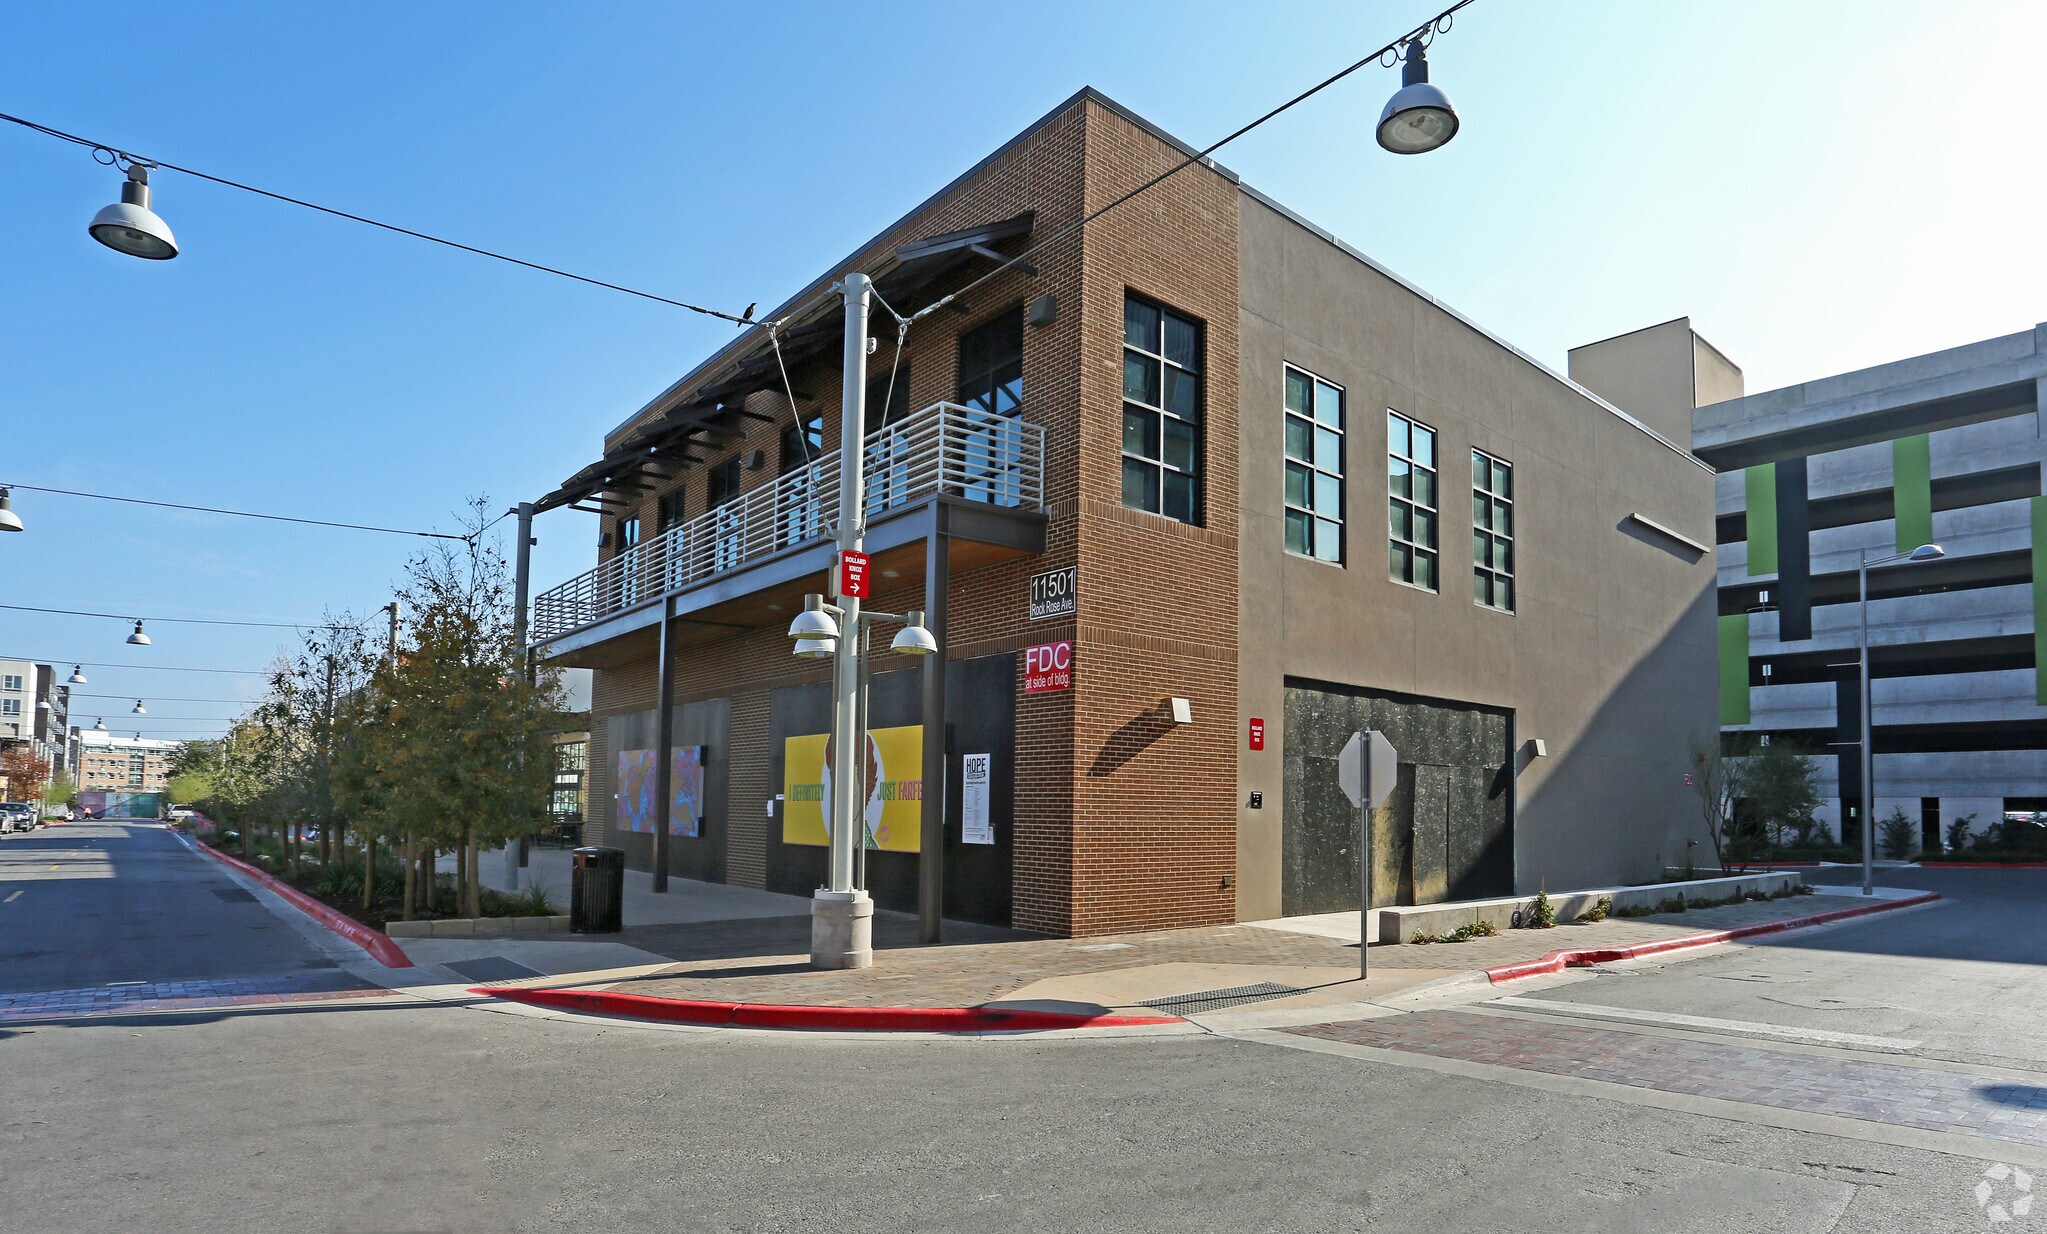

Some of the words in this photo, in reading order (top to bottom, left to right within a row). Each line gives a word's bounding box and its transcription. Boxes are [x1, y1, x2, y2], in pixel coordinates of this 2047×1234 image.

[845, 556, 866, 565] BOLLARD
[849, 565, 862, 573] KNOX
[1032, 569, 1073, 600] 11501
[1031, 602, 1046, 617] Rock
[1046, 600, 1061, 614] Rose
[1061, 597, 1074, 611] Ave.
[1026, 642, 1070, 674] FDC
[1025, 677, 1033, 689] at
[1033, 675, 1047, 688] side
[1047, 672, 1054, 687] of
[1054, 671, 1071, 687] bldg.
[966, 757, 987, 773] HOPE
[877, 781, 897, 801] JUST
